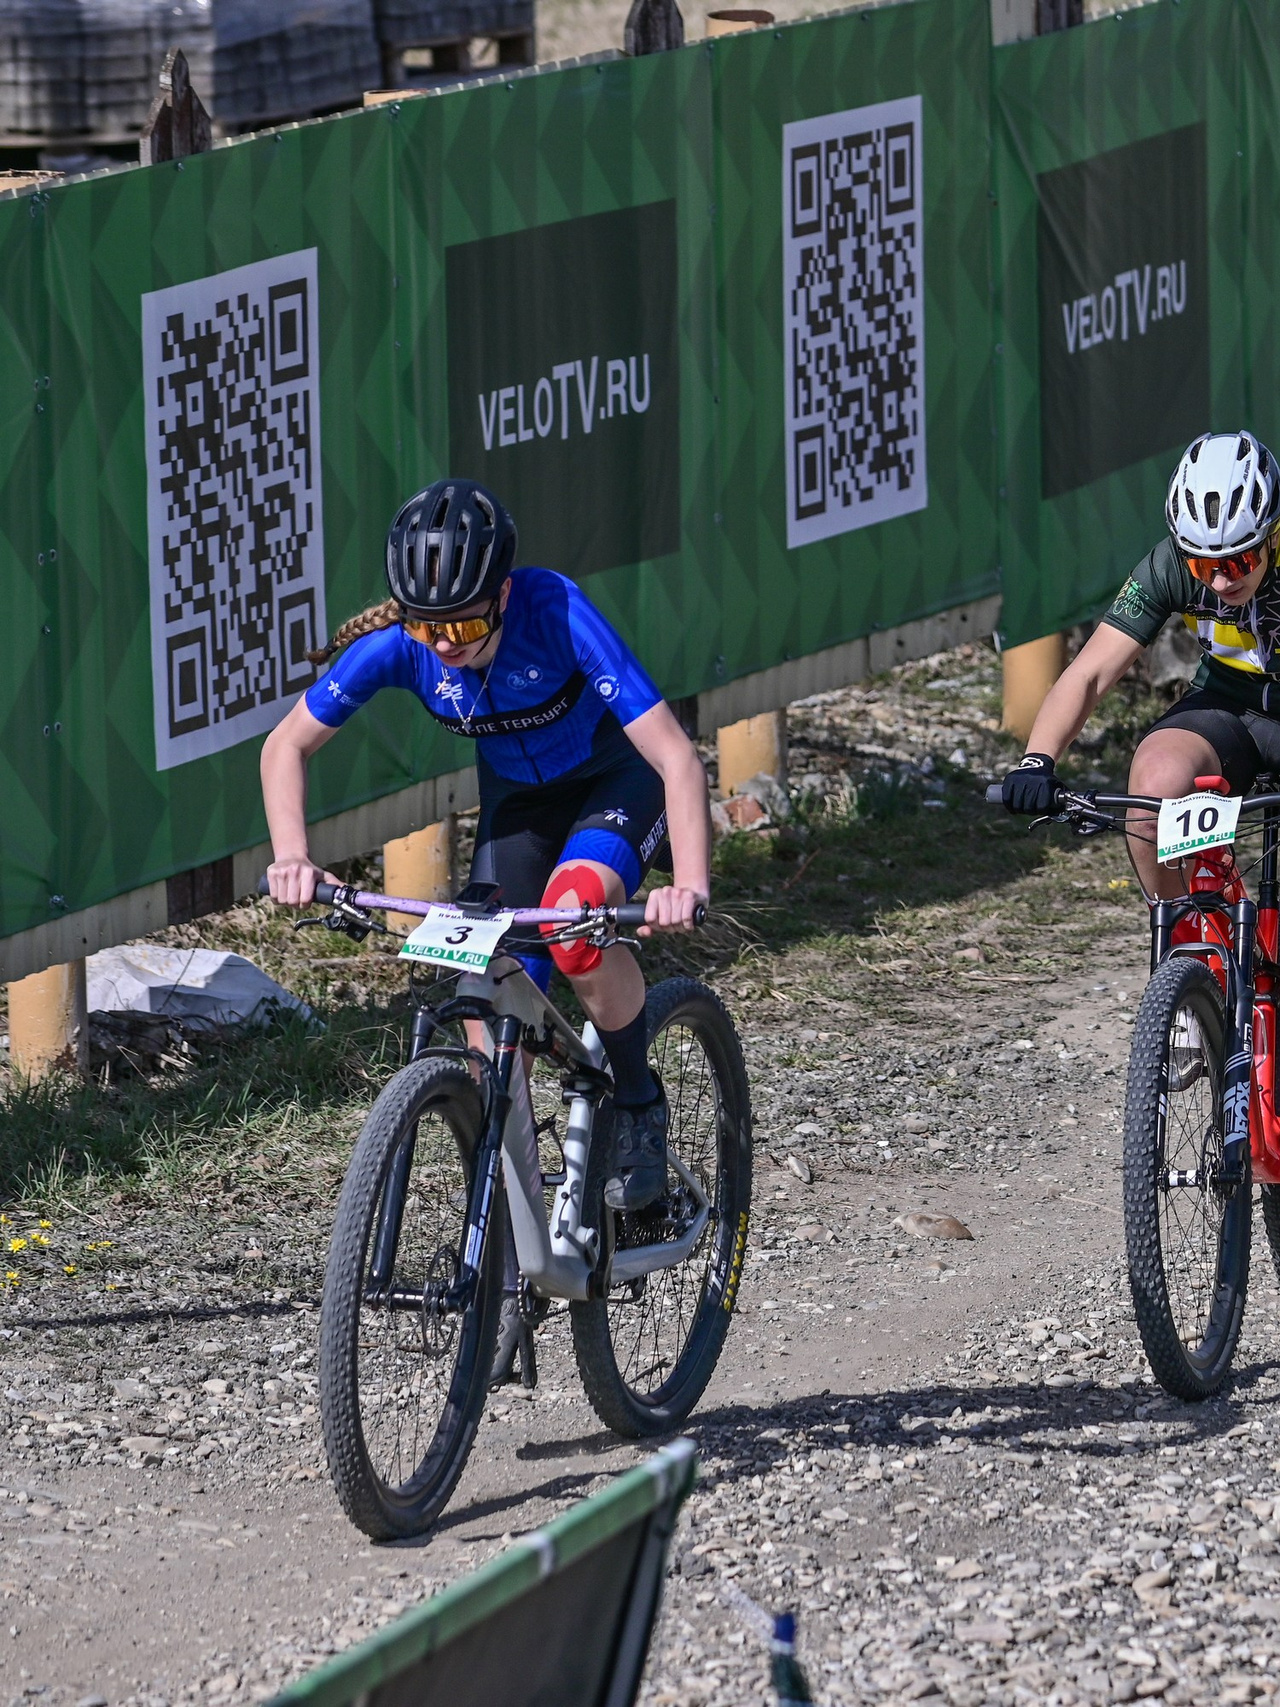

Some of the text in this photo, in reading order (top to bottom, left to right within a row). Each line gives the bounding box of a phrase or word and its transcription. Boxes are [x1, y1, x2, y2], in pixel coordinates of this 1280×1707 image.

[1062, 259, 1187, 355] VELOTV.RU
[478, 353, 651, 451] VELOTV.RU
[1175, 806, 1220, 838] 10
[1163, 832, 1231, 854] VELOTV.RU
[445, 926, 474, 945] 3
[408, 944, 485, 965] VELOTV.RU
[723, 1211, 748, 1313] MAXXIS
